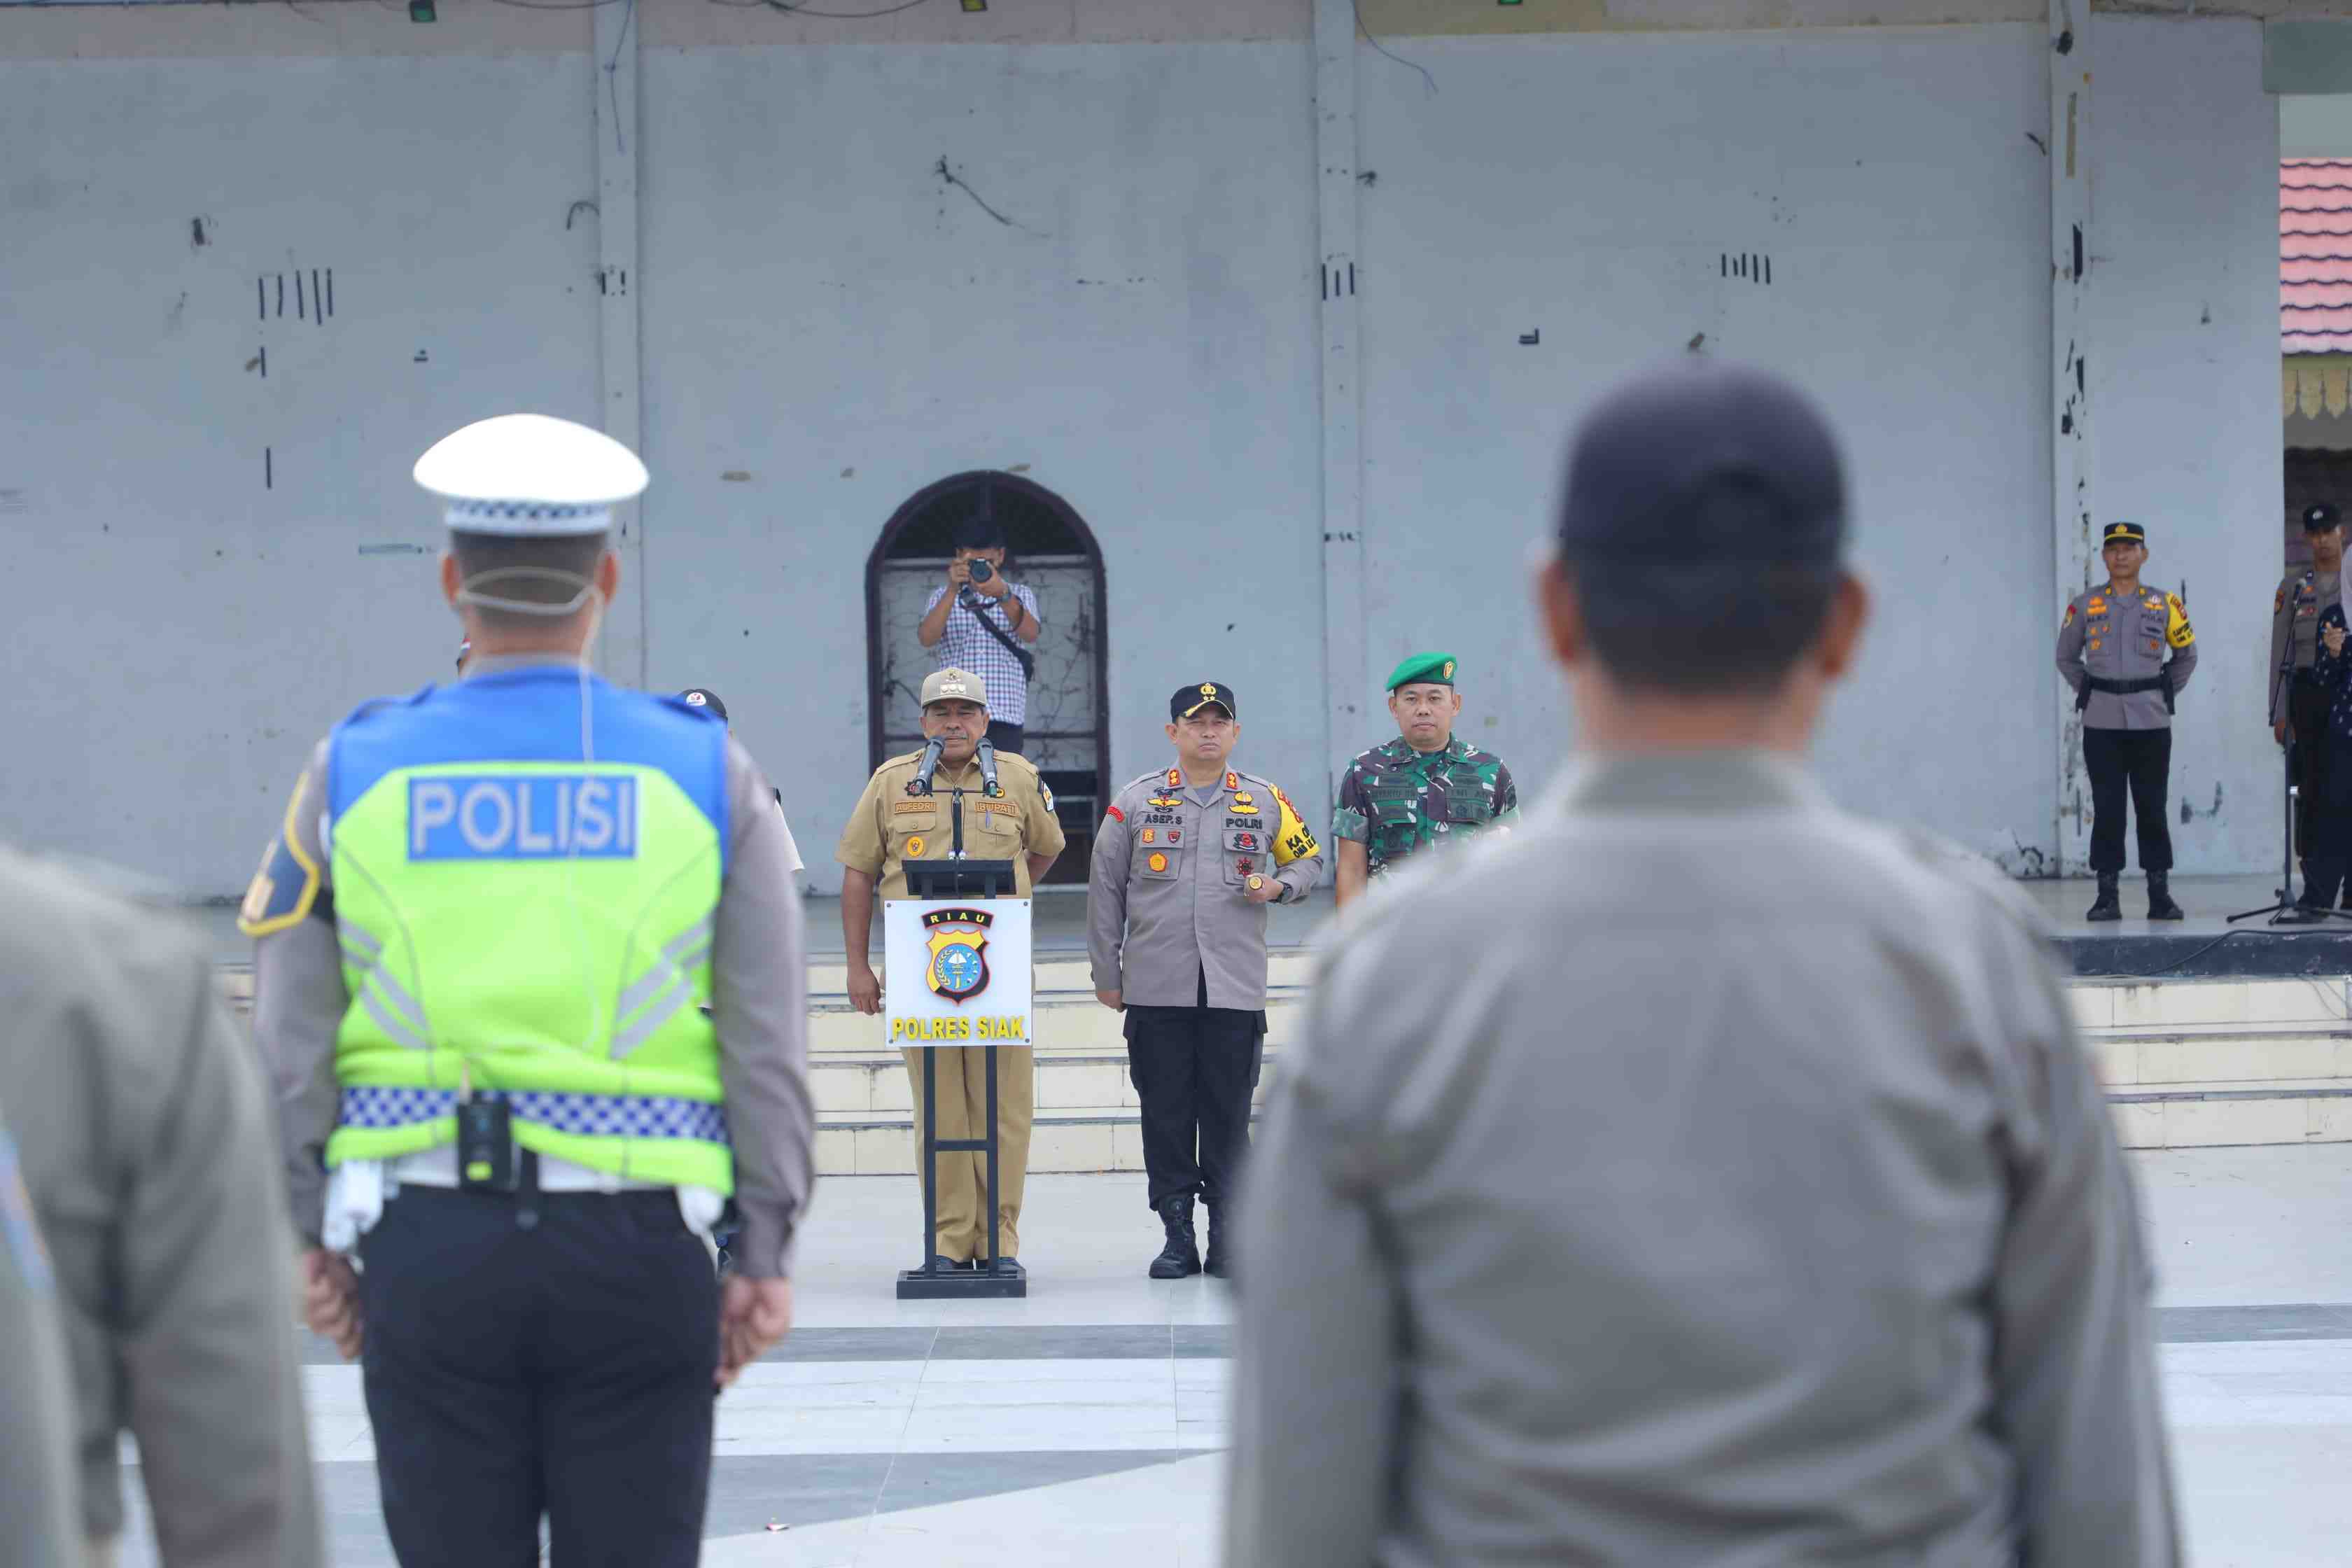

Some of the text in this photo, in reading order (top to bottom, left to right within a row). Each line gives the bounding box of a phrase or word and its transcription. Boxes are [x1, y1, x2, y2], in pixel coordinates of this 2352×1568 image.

[979, 803, 1016, 814] BUPATI
[414, 780, 629, 852] POLISI
[1226, 818, 1263, 830] POLRI
[930, 912, 985, 923] RIAU
[892, 1015, 1026, 1041] POLRES SIAK
